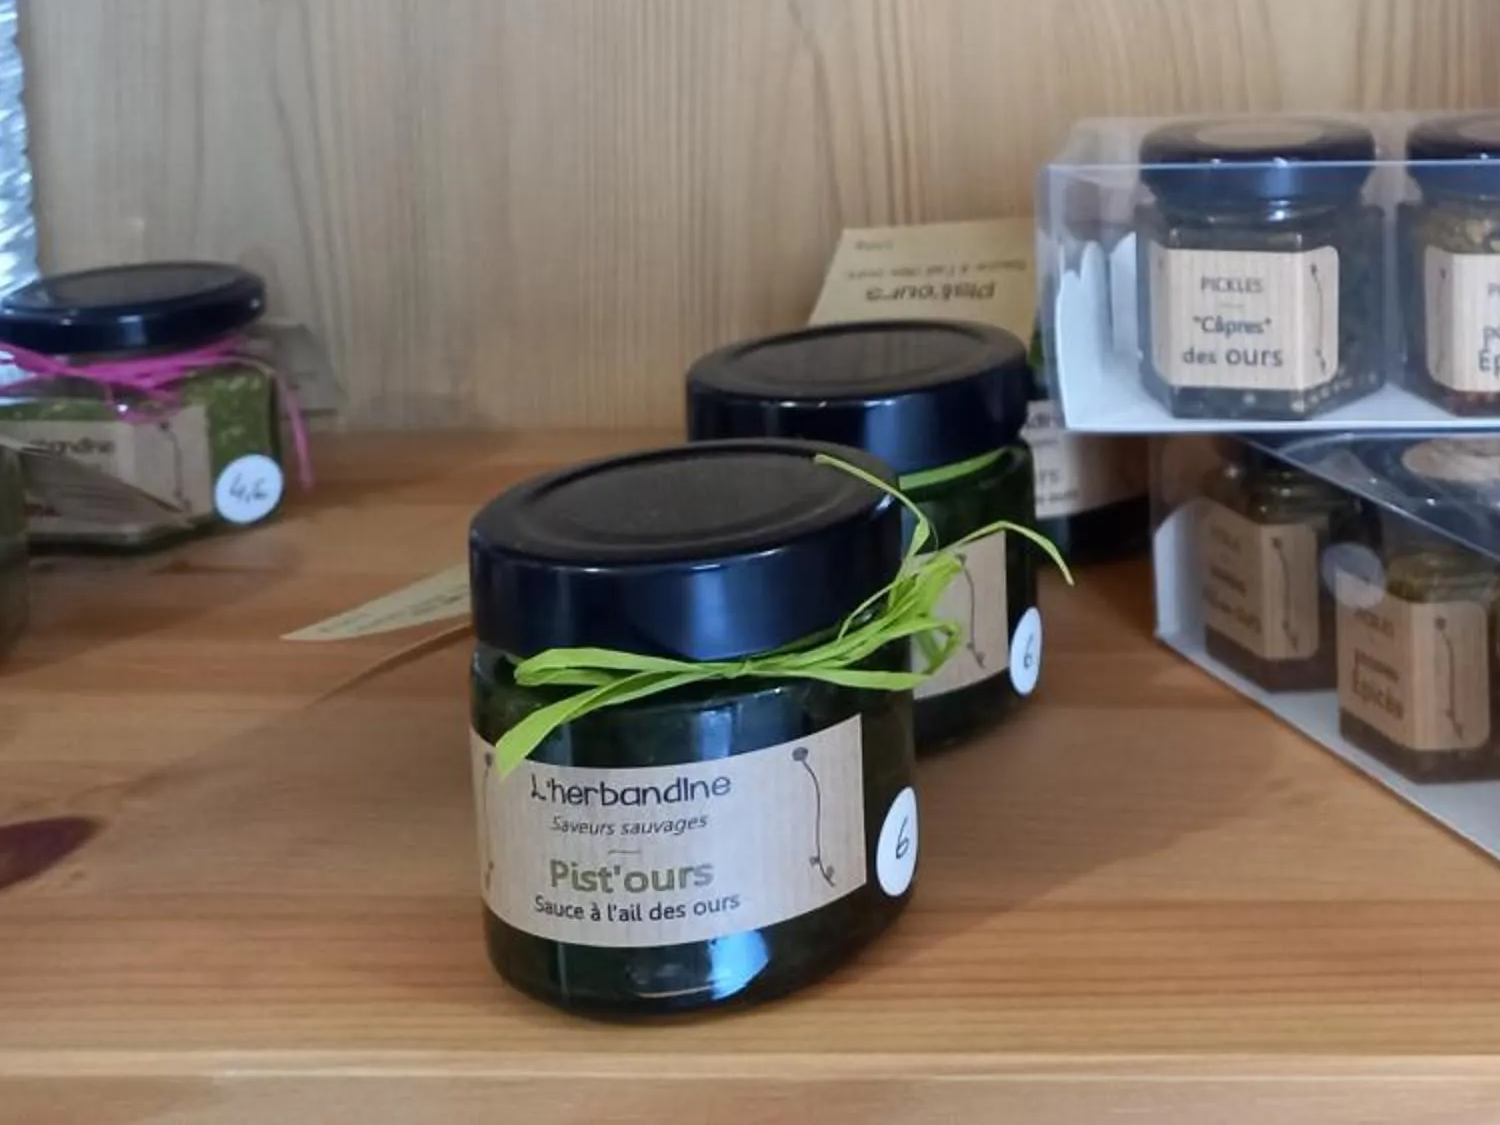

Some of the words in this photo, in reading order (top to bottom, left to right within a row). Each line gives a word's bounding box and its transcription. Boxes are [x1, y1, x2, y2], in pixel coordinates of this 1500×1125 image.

[1200, 276, 1264, 294] PICKLES
[1182, 348, 1217, 365] des
[1226, 348, 1284, 367] ours
[551, 815, 615, 836] Saveurs
[620, 814, 709, 836] sauvages
[895, 816, 910, 860] 6
[550, 859, 715, 894] Pist'ours
[535, 894, 585, 920] Sauce
[590, 902, 602, 922] à
[607, 903, 643, 922] l'ail
[649, 901, 687, 922] des
[693, 893, 741, 916] ours
